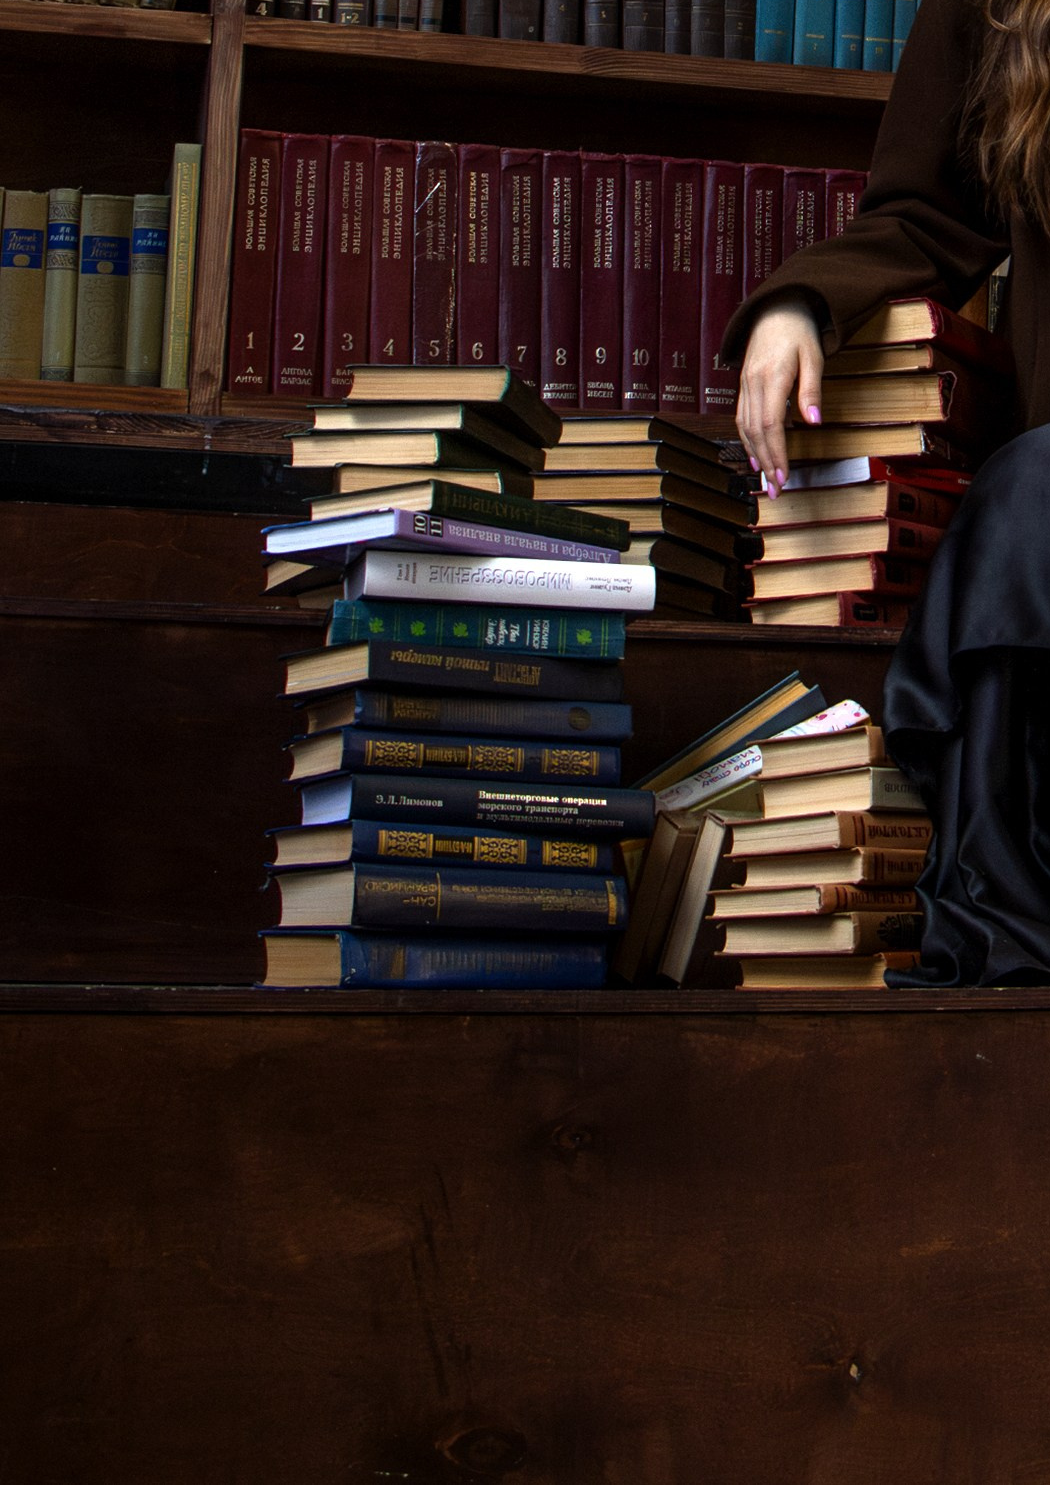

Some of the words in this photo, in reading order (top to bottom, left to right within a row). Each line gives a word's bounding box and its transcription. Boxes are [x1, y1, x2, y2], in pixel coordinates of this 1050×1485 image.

[256, 2, 267, 16] 4
[317, 7, 323, 18] 1
[341, 12, 360, 23] 1-2
[469, 171, 477, 219] СОВЕТСКАЯ
[595, 177, 603, 225] СОВЕТСКАЯ
[393, 167, 404, 259] ЭНЦИКЛОПЕДИЯ
[481, 172, 489, 264] ЭНЦИКЛОПЕДИЯ
[563, 177, 572, 269] ЭНЦИКЛОПЕДИЯ
[604, 178, 614, 269] ЭНЦИКЛОПЕДИЯ
[382, 219, 391, 258] БОЛЬШАЯ
[552, 229, 560, 268] БОЛЬШАЯ
[594, 229, 602, 268] БОЛЬШАЯ
[245, 332, 255, 349] 1
[292, 333, 305, 351] 2
[341, 333, 353, 351] 3
[383, 338, 394, 356] 4
[429, 340, 440, 357] 5
[472, 342, 483, 360] 6
[517, 346, 527, 363] 7
[556, 348, 567, 365] 8
[595, 347, 606, 364] 9
[632, 348, 649, 365] 10
[672, 351, 687, 368] 11
[414, 516, 427, 534] 10
[430, 519, 443, 536] 11
[448, 525, 500, 543] анализа
[504, 535, 547, 552] начала
[562, 545, 612, 564] Алгебра
[429, 565, 572, 590] МИРОВОЗЗРЕНИЕ
[509, 622, 520, 643] Твоя
[390, 649, 443, 668] камеры
[446, 657, 490, 672] пятой
[734, 754, 762, 773] скоро
[478, 790, 559, 805] Внешнеторговые
[562, 795, 607, 808] операции
[477, 802, 522, 815] морского
[525, 805, 579, 818] транспорта
[486, 813, 574, 827] мультимодальные
[576, 817, 624, 830] перевозки
